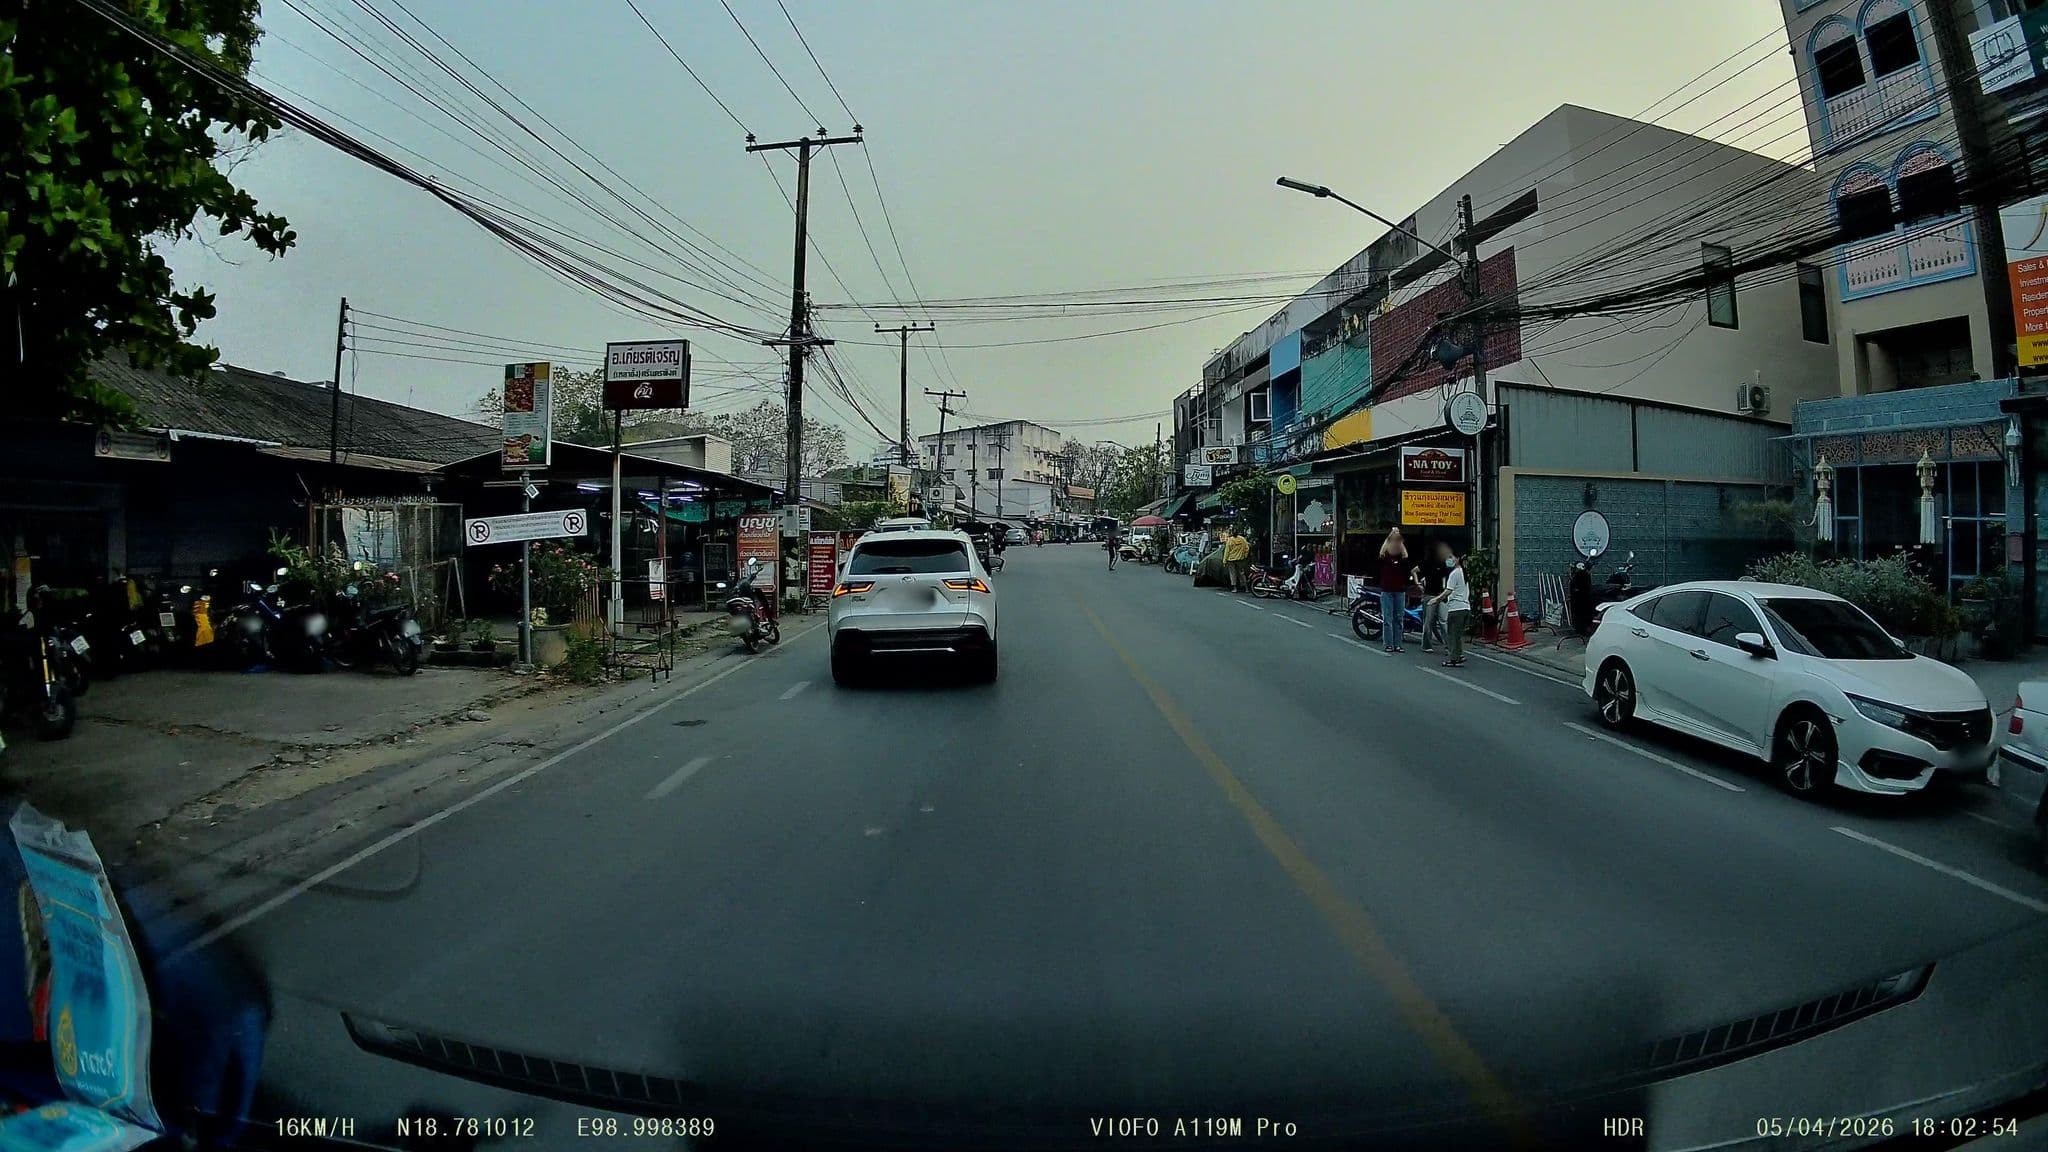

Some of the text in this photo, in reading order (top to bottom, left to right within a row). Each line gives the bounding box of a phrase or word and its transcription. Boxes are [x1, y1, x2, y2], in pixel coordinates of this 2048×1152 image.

[2017, 260, 2046, 273] Sales &
[2025, 322, 2045, 333] More
[612, 347, 680, 366] อ.เกียรติเจริญ
[1413, 460, 1452, 469] NA TOY
[740, 517, 776, 532] บุญชู
